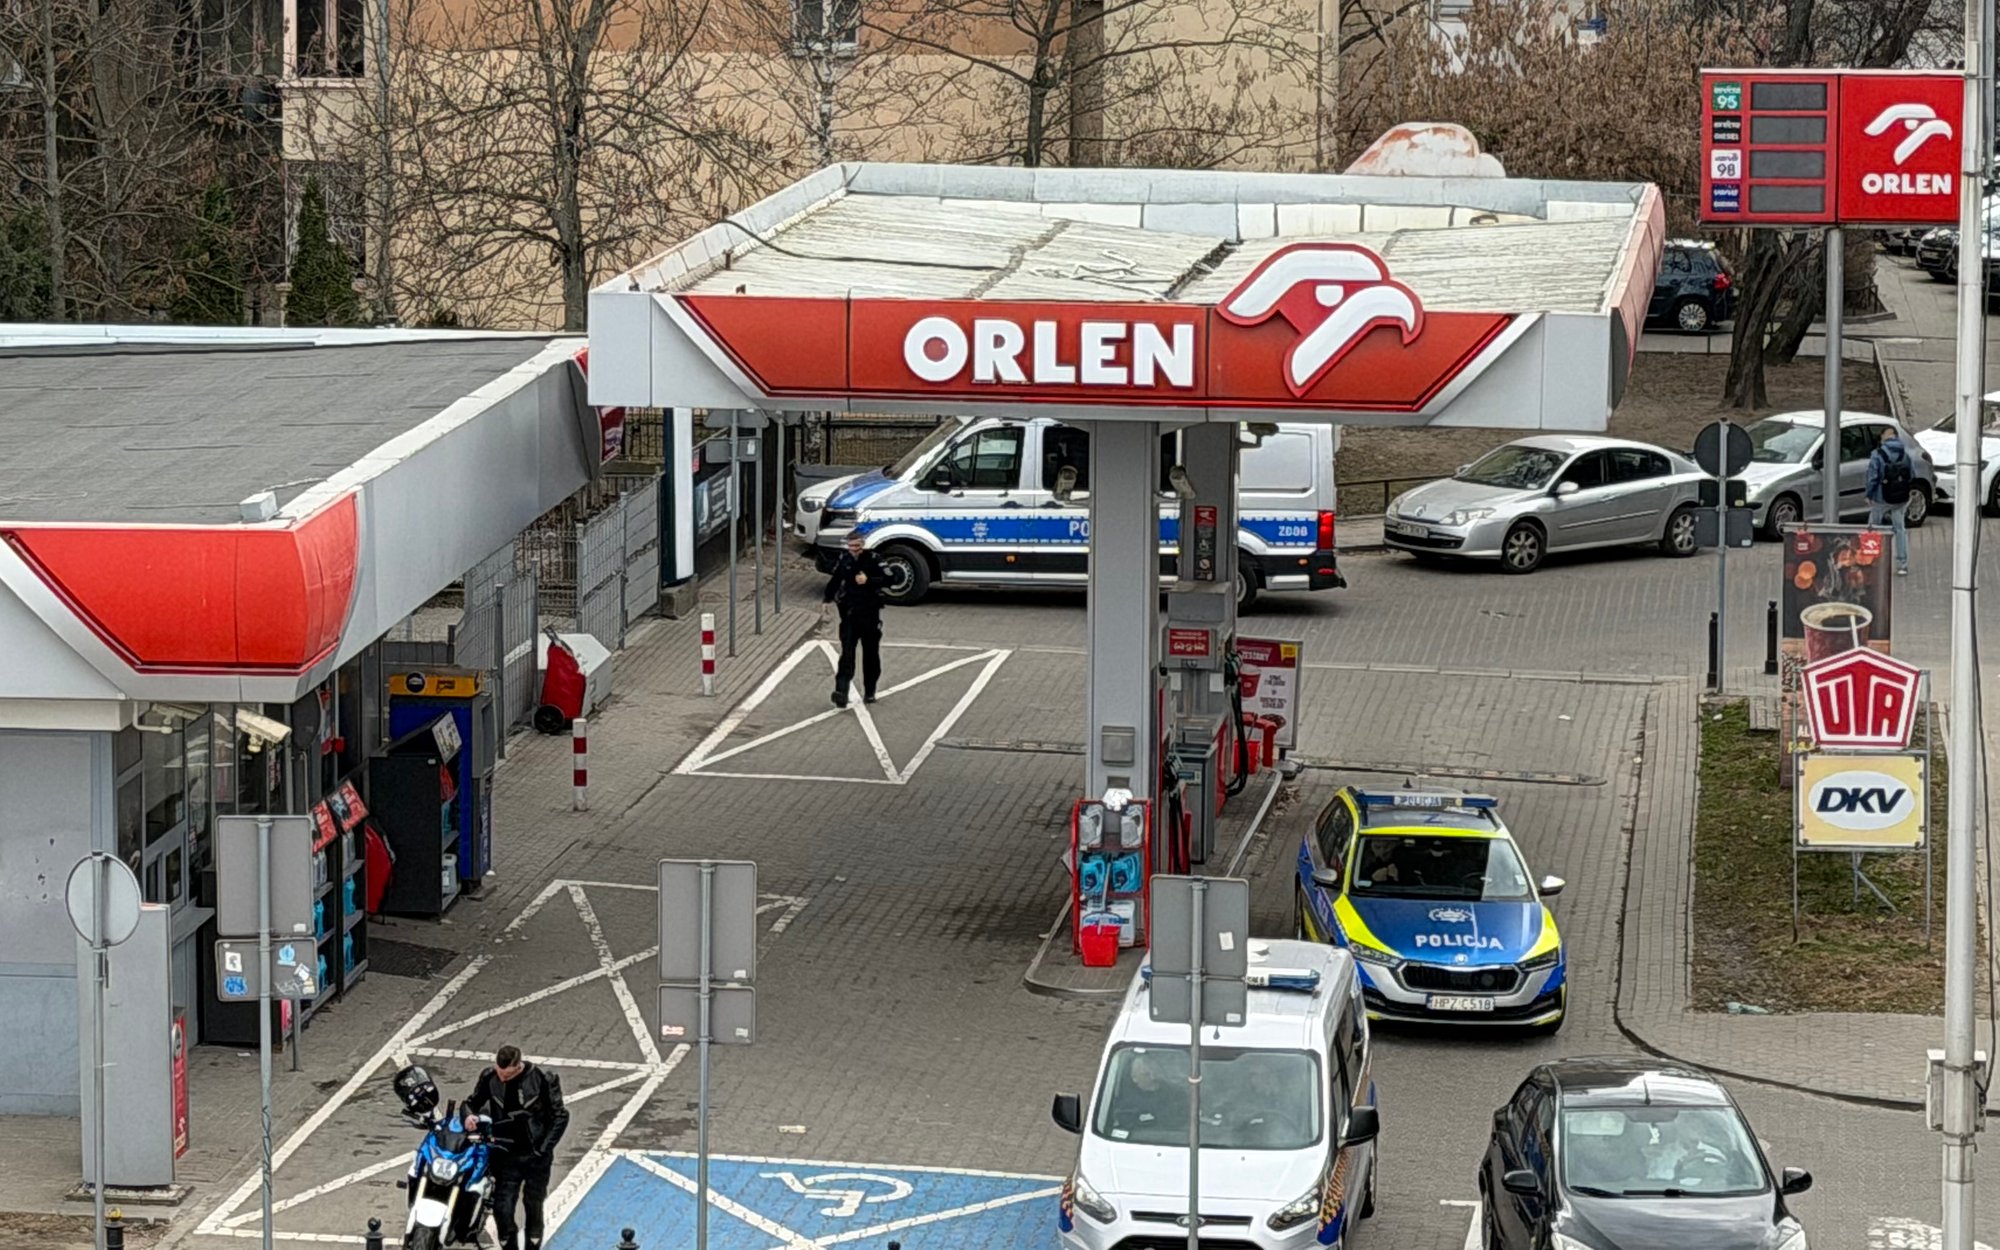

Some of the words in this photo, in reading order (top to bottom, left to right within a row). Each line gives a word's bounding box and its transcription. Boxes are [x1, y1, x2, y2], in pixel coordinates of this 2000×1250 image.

[1717, 95, 1737, 109] 95
[1717, 163, 1736, 177] 98
[1861, 174, 1951, 195] ORLEN
[904, 316, 1194, 387] ORLEN
[1815, 660, 1908, 736] UTA
[1816, 787, 1906, 814] DKV
[1415, 934, 1504, 951] POLICJA
